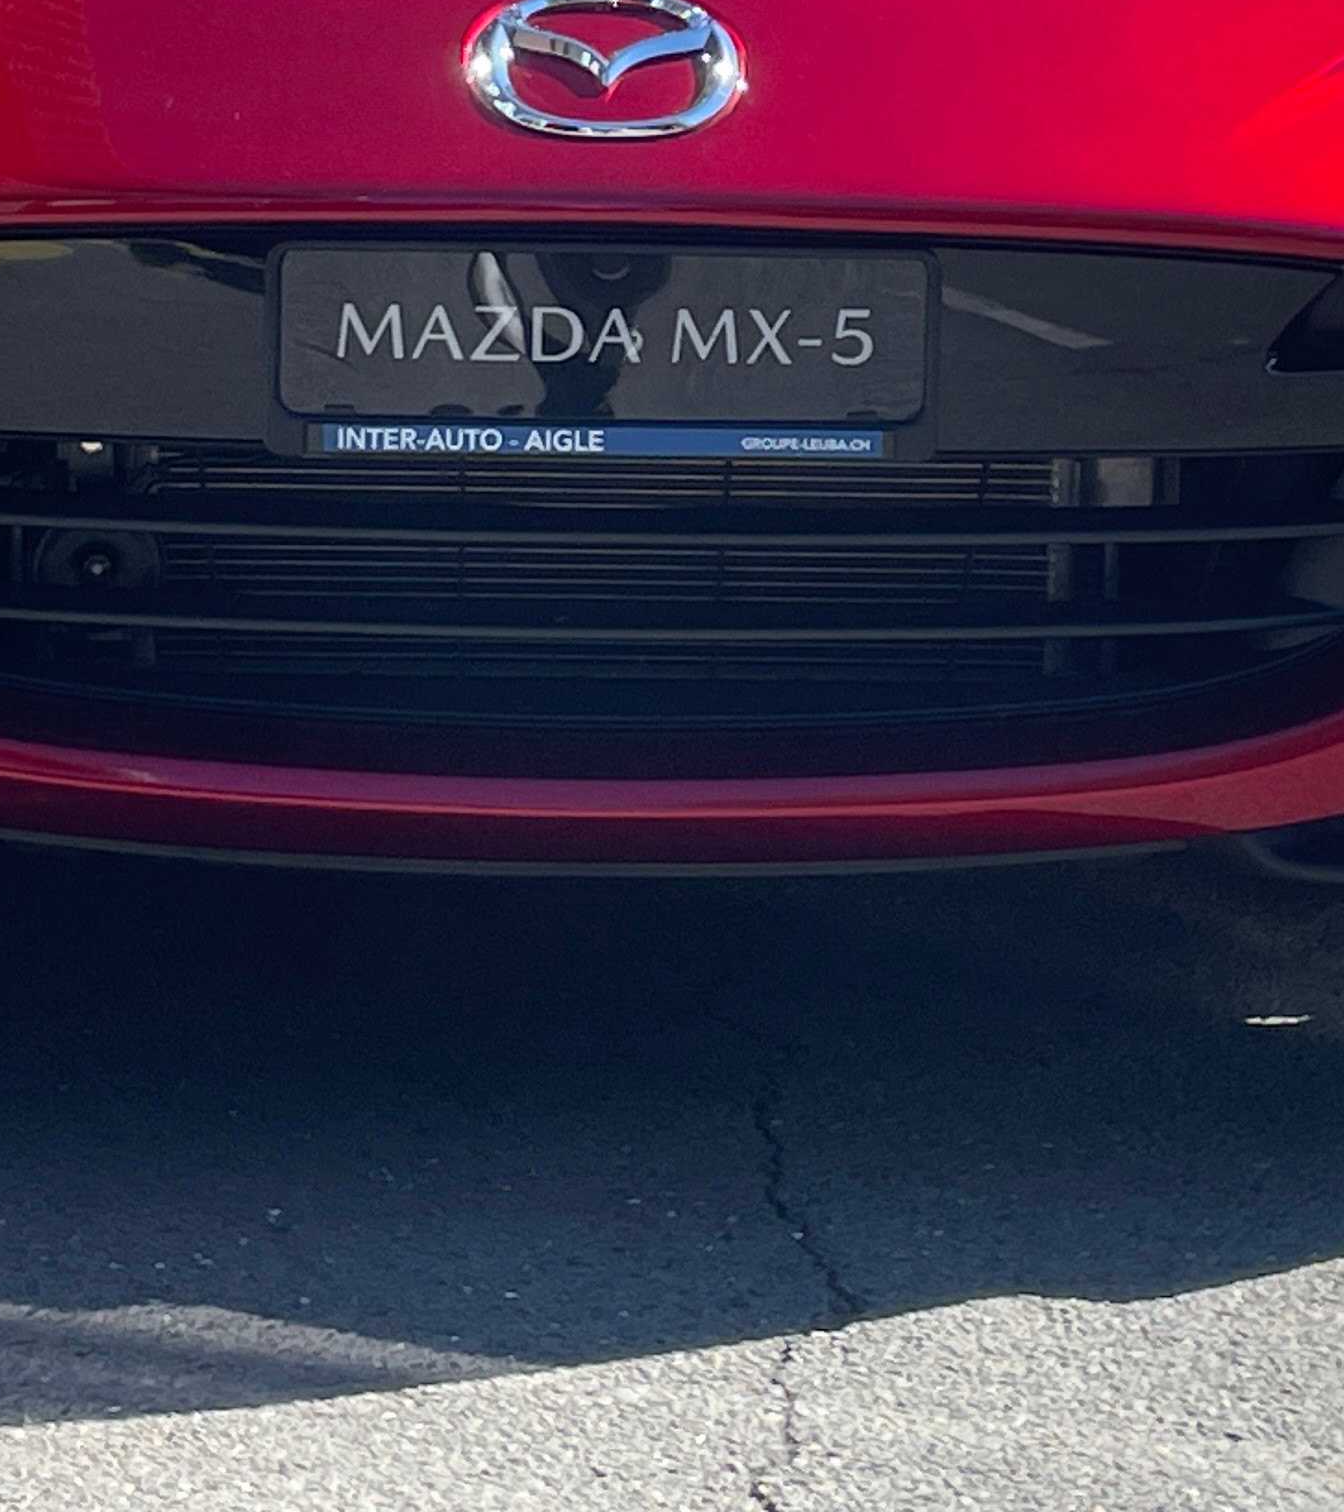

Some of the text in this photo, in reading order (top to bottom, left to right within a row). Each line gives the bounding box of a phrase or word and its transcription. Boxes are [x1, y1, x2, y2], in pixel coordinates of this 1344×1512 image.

[336, 303, 875, 366] MAZDA MX-5
[336, 427, 503, 451] INTER-AUTO
[523, 429, 605, 453] AIGLE
